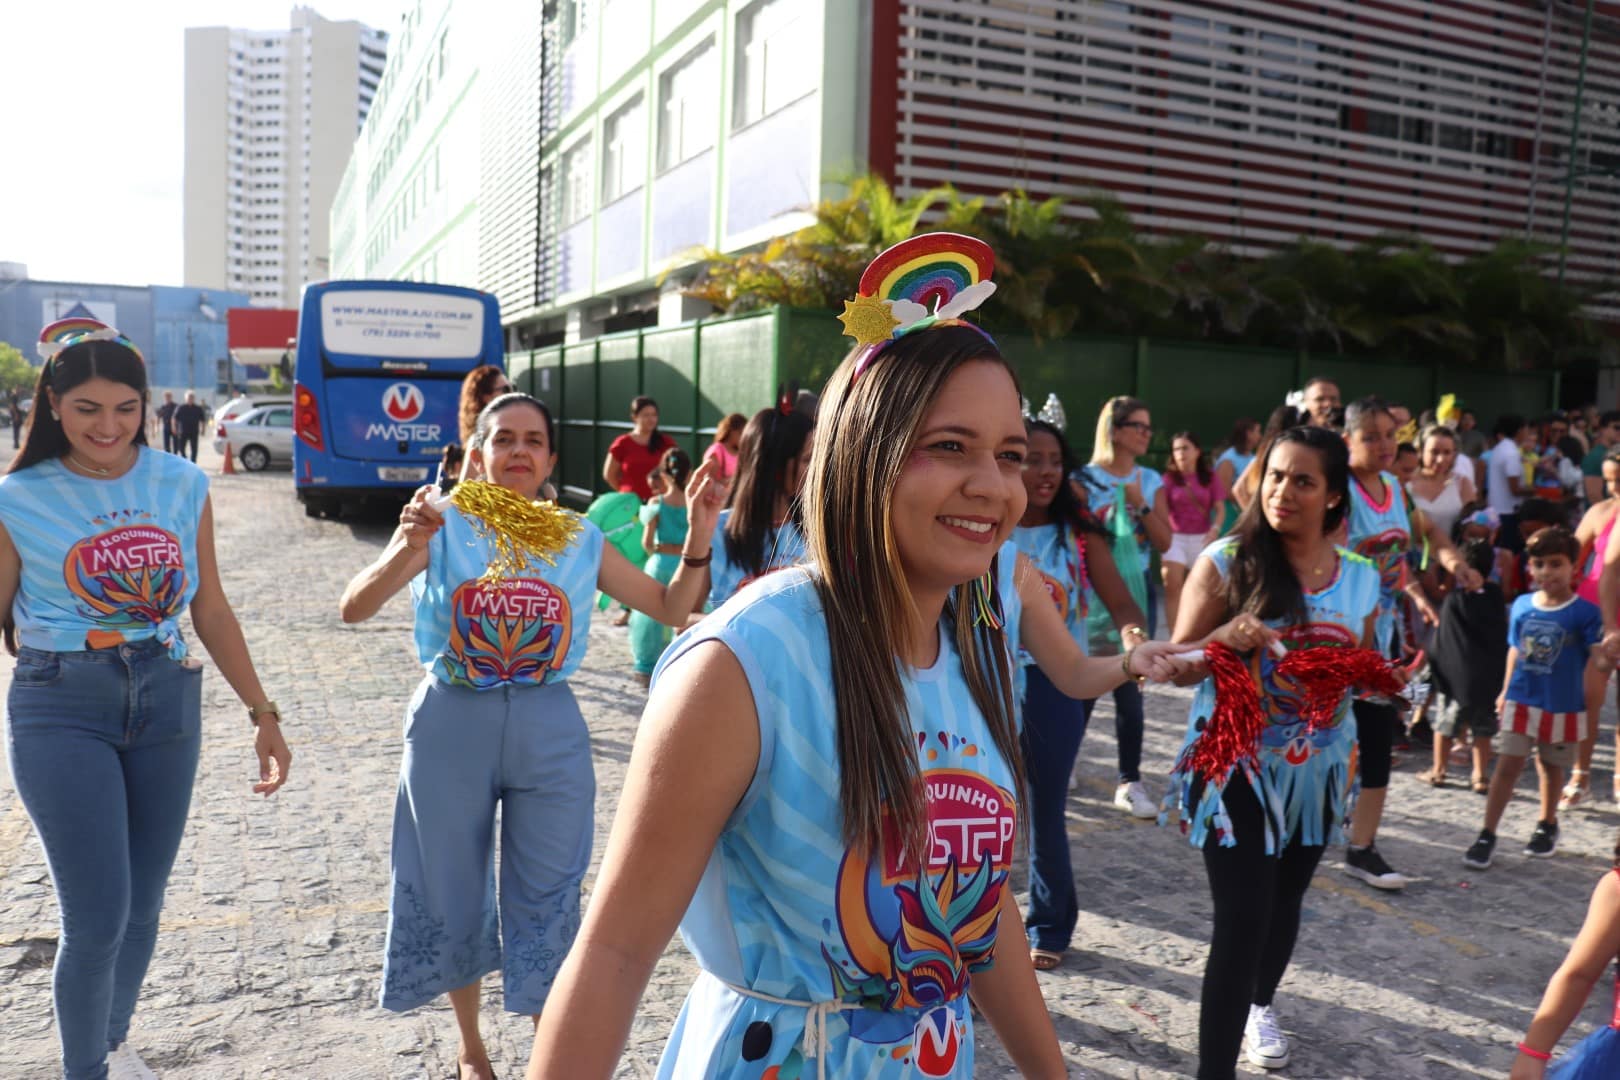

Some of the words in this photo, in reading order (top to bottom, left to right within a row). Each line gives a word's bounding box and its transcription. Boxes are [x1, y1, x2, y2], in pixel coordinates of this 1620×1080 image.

[365, 423, 441, 441] MASTER
[100, 529, 167, 547] BLOQUINHO
[93, 542, 180, 571] MASTER
[470, 591, 561, 620] MASTER
[924, 783, 999, 815] QUINHO
